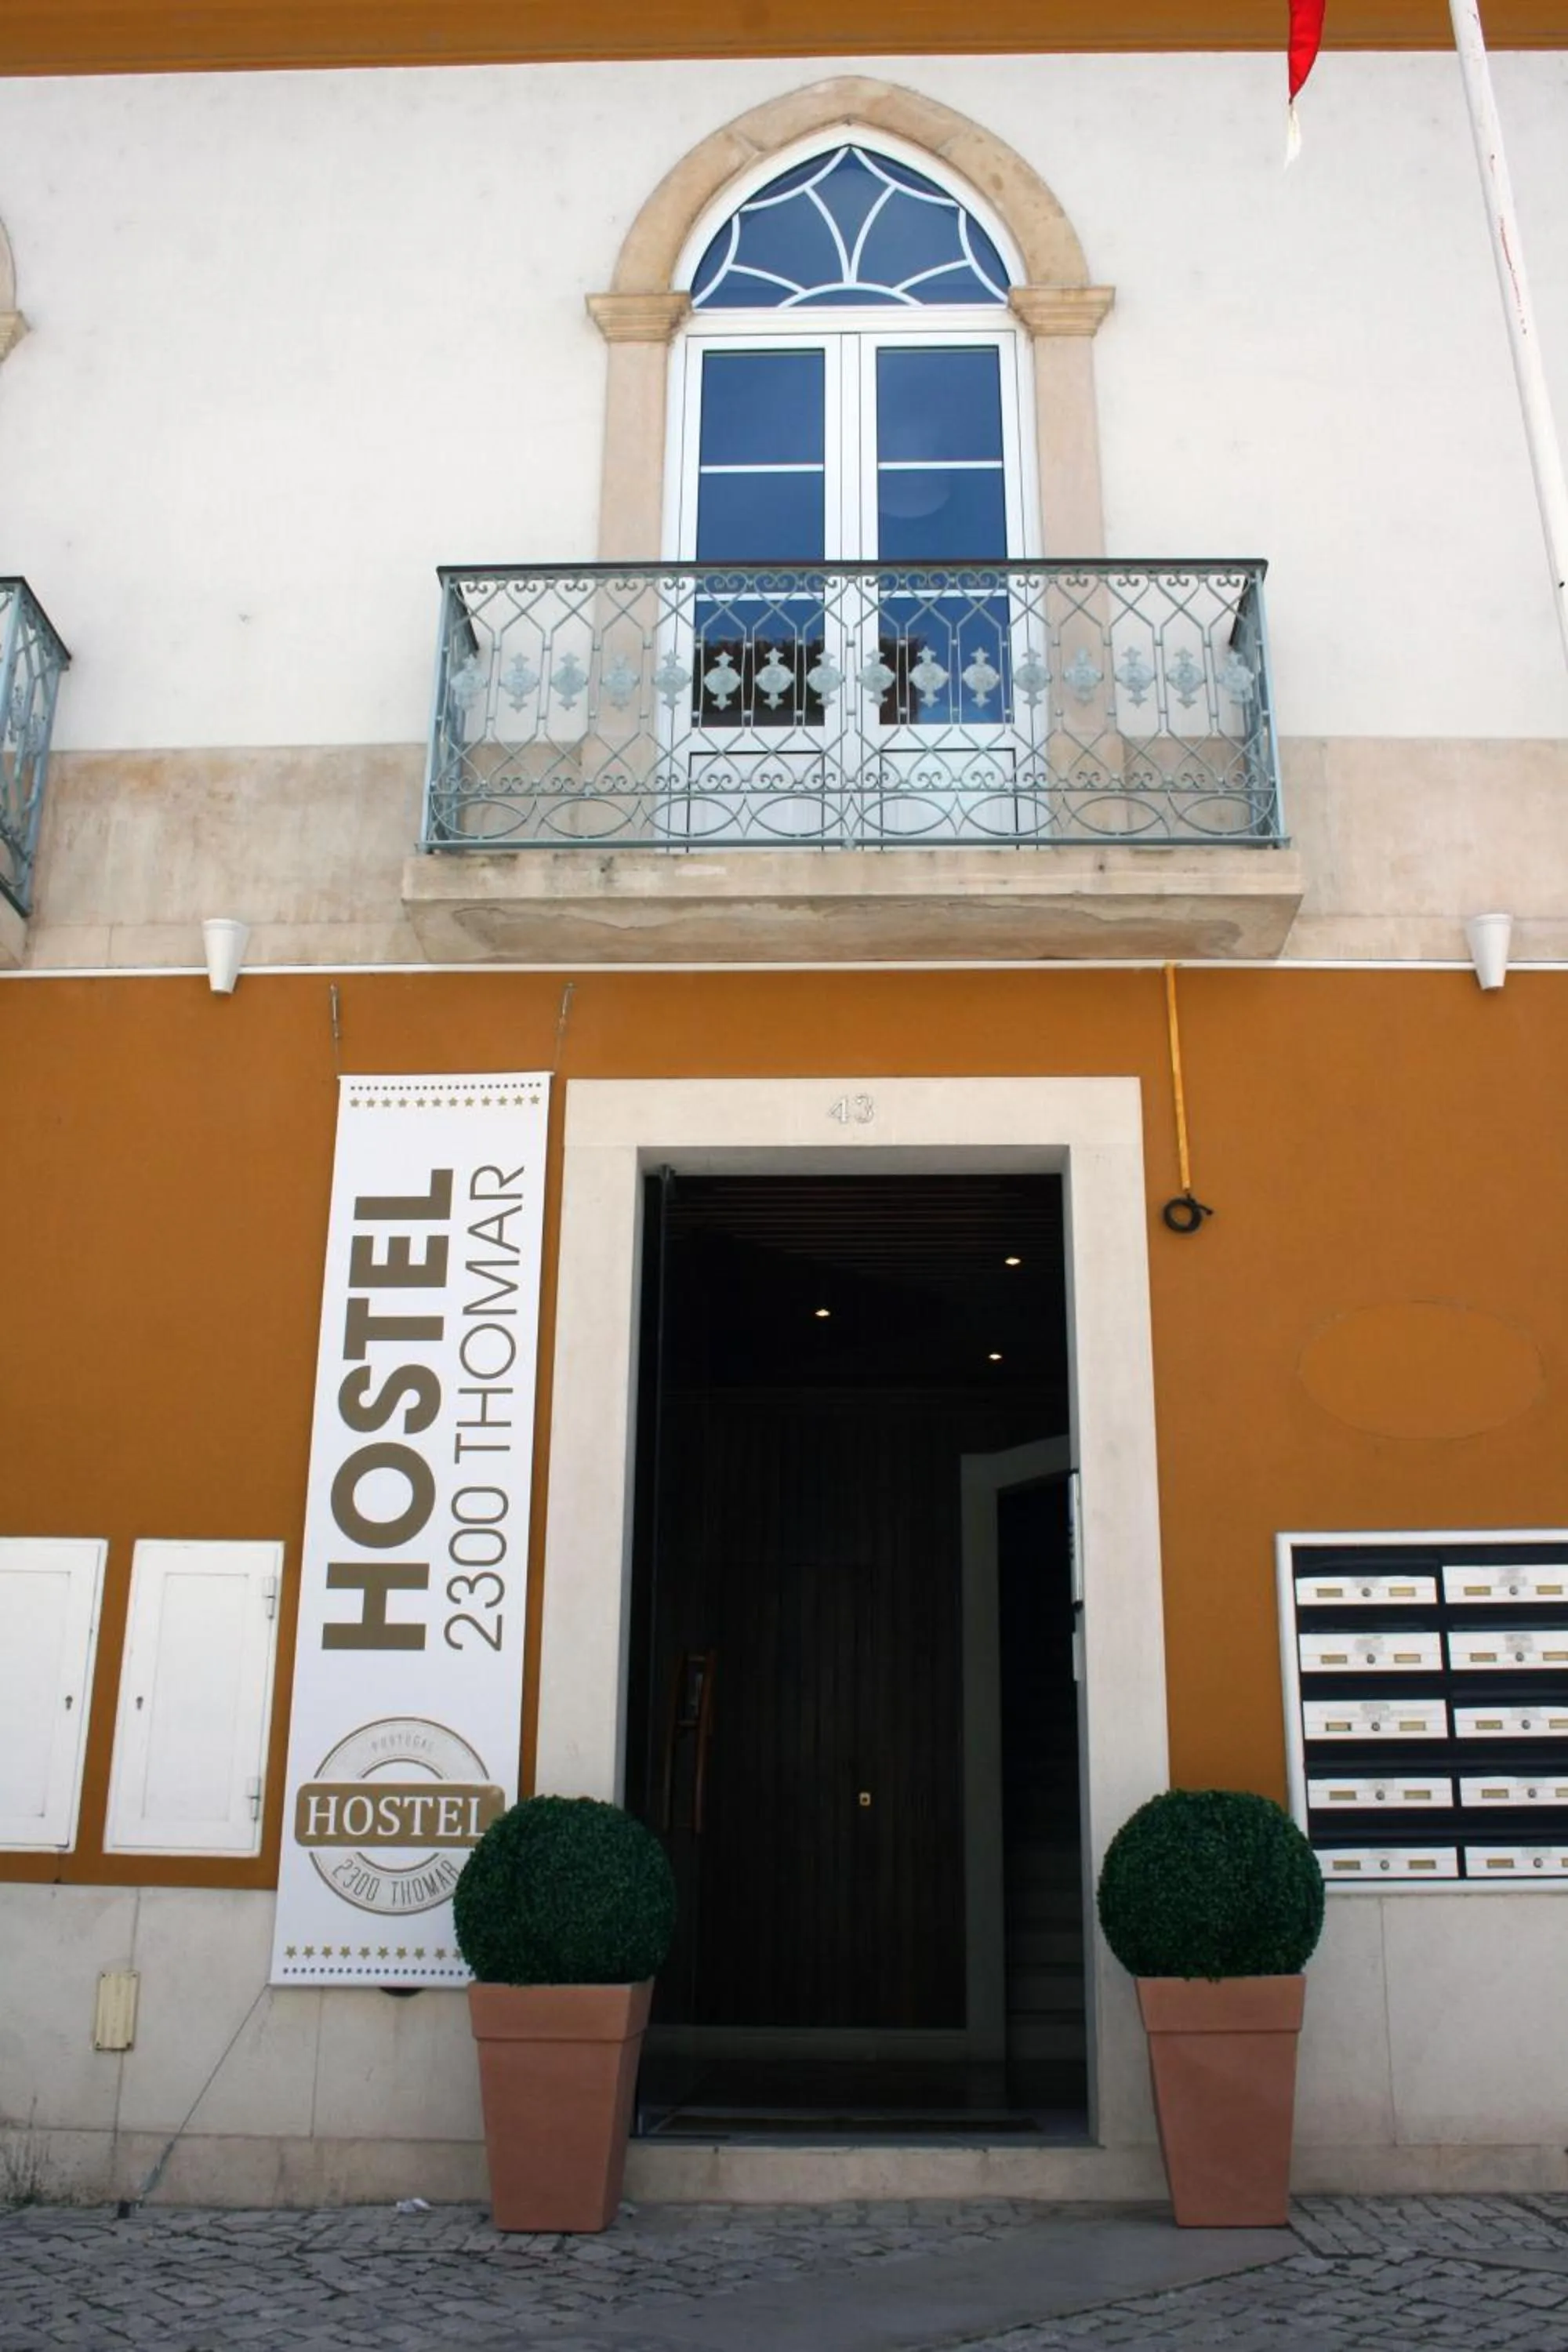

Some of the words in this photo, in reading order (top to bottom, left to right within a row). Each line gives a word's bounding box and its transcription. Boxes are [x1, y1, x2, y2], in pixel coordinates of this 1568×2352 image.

[827, 1093, 874, 1123] 43
[455, 1165, 524, 1464] THOMAR
[321, 1168, 454, 1651] HOSTEL
[444, 1486, 509, 1652] 2300
[305, 1795, 485, 1837] HOSTEL
[332, 1858, 380, 1901] 2300
[391, 1860, 460, 1906] THOMAR
